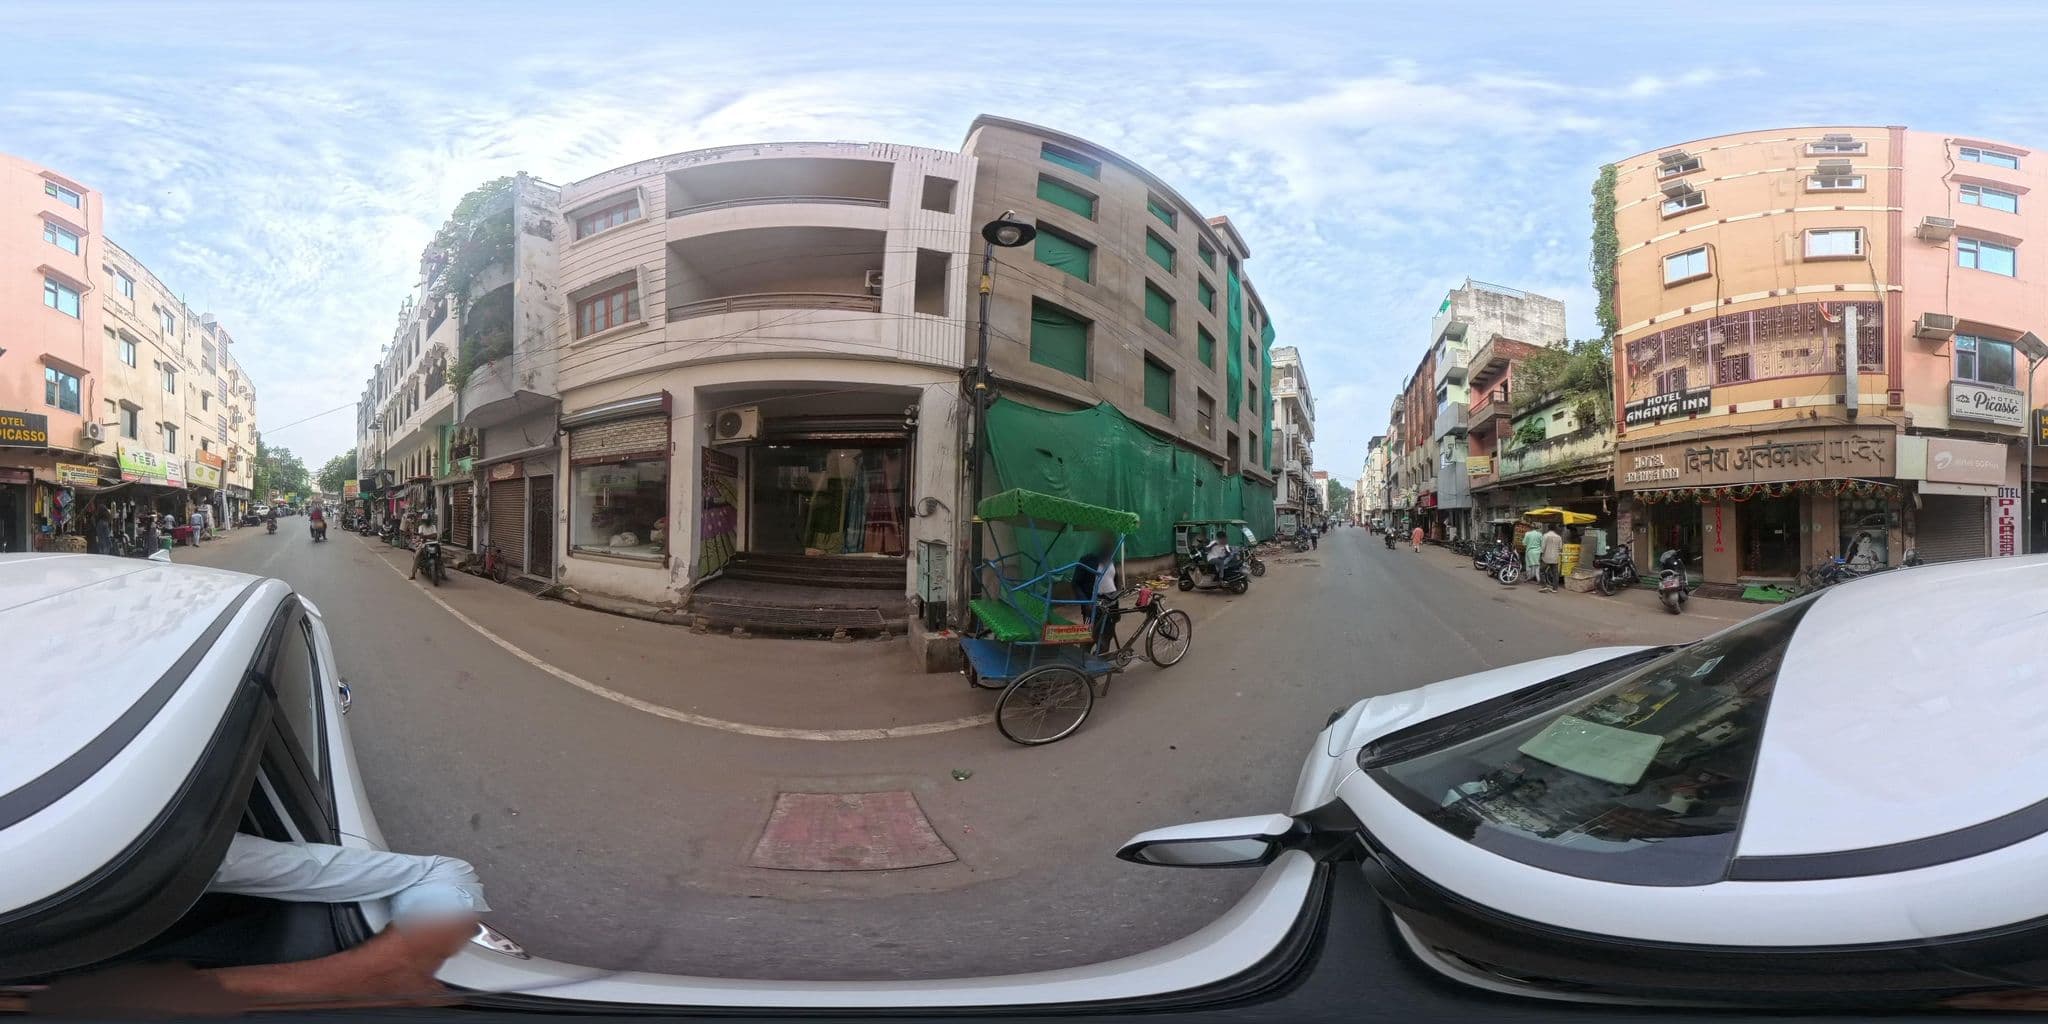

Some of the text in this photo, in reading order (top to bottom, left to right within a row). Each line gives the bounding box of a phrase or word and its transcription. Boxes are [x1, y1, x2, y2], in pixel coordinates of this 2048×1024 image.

[1647, 392, 1681, 407] HOTEL
[1973, 391, 2019, 415] Picasso
[1991, 395, 2020, 405] HOTEL
[1626, 397, 1709, 423] ANANYA INN
[0, 416, 25, 427] OTEL
[0, 428, 46, 442] ICASSO
[1635, 454, 1665, 469] HOTEL
[1684, 445, 1730, 474] दिनेश
[1998, 487, 2021, 498] OTEL
